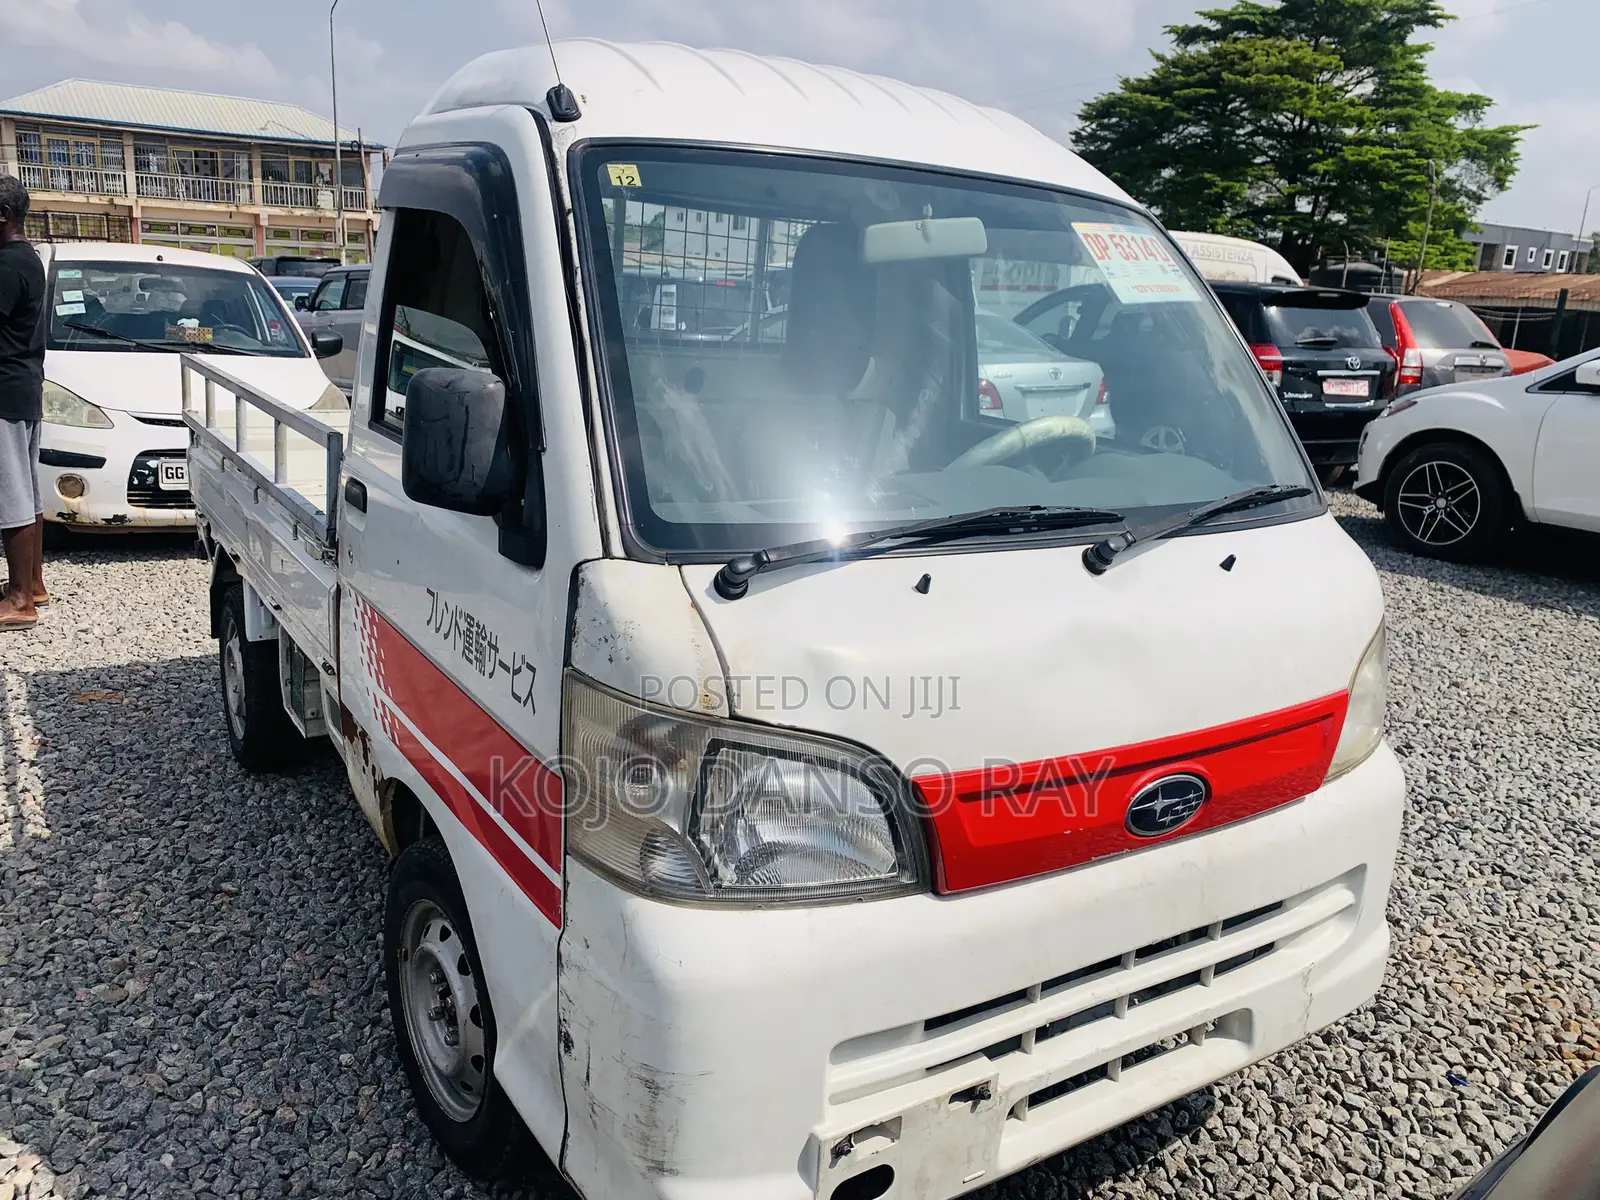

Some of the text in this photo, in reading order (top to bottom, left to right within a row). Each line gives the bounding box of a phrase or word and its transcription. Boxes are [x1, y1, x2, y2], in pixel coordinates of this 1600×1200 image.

[615, 175, 637, 186] 12
[1082, 233, 1112, 261] DP
[1191, 244, 1254, 262] ASSISTENZA
[165, 466, 185, 480] GG
[426, 587, 537, 716] フレンド運輸サービス
